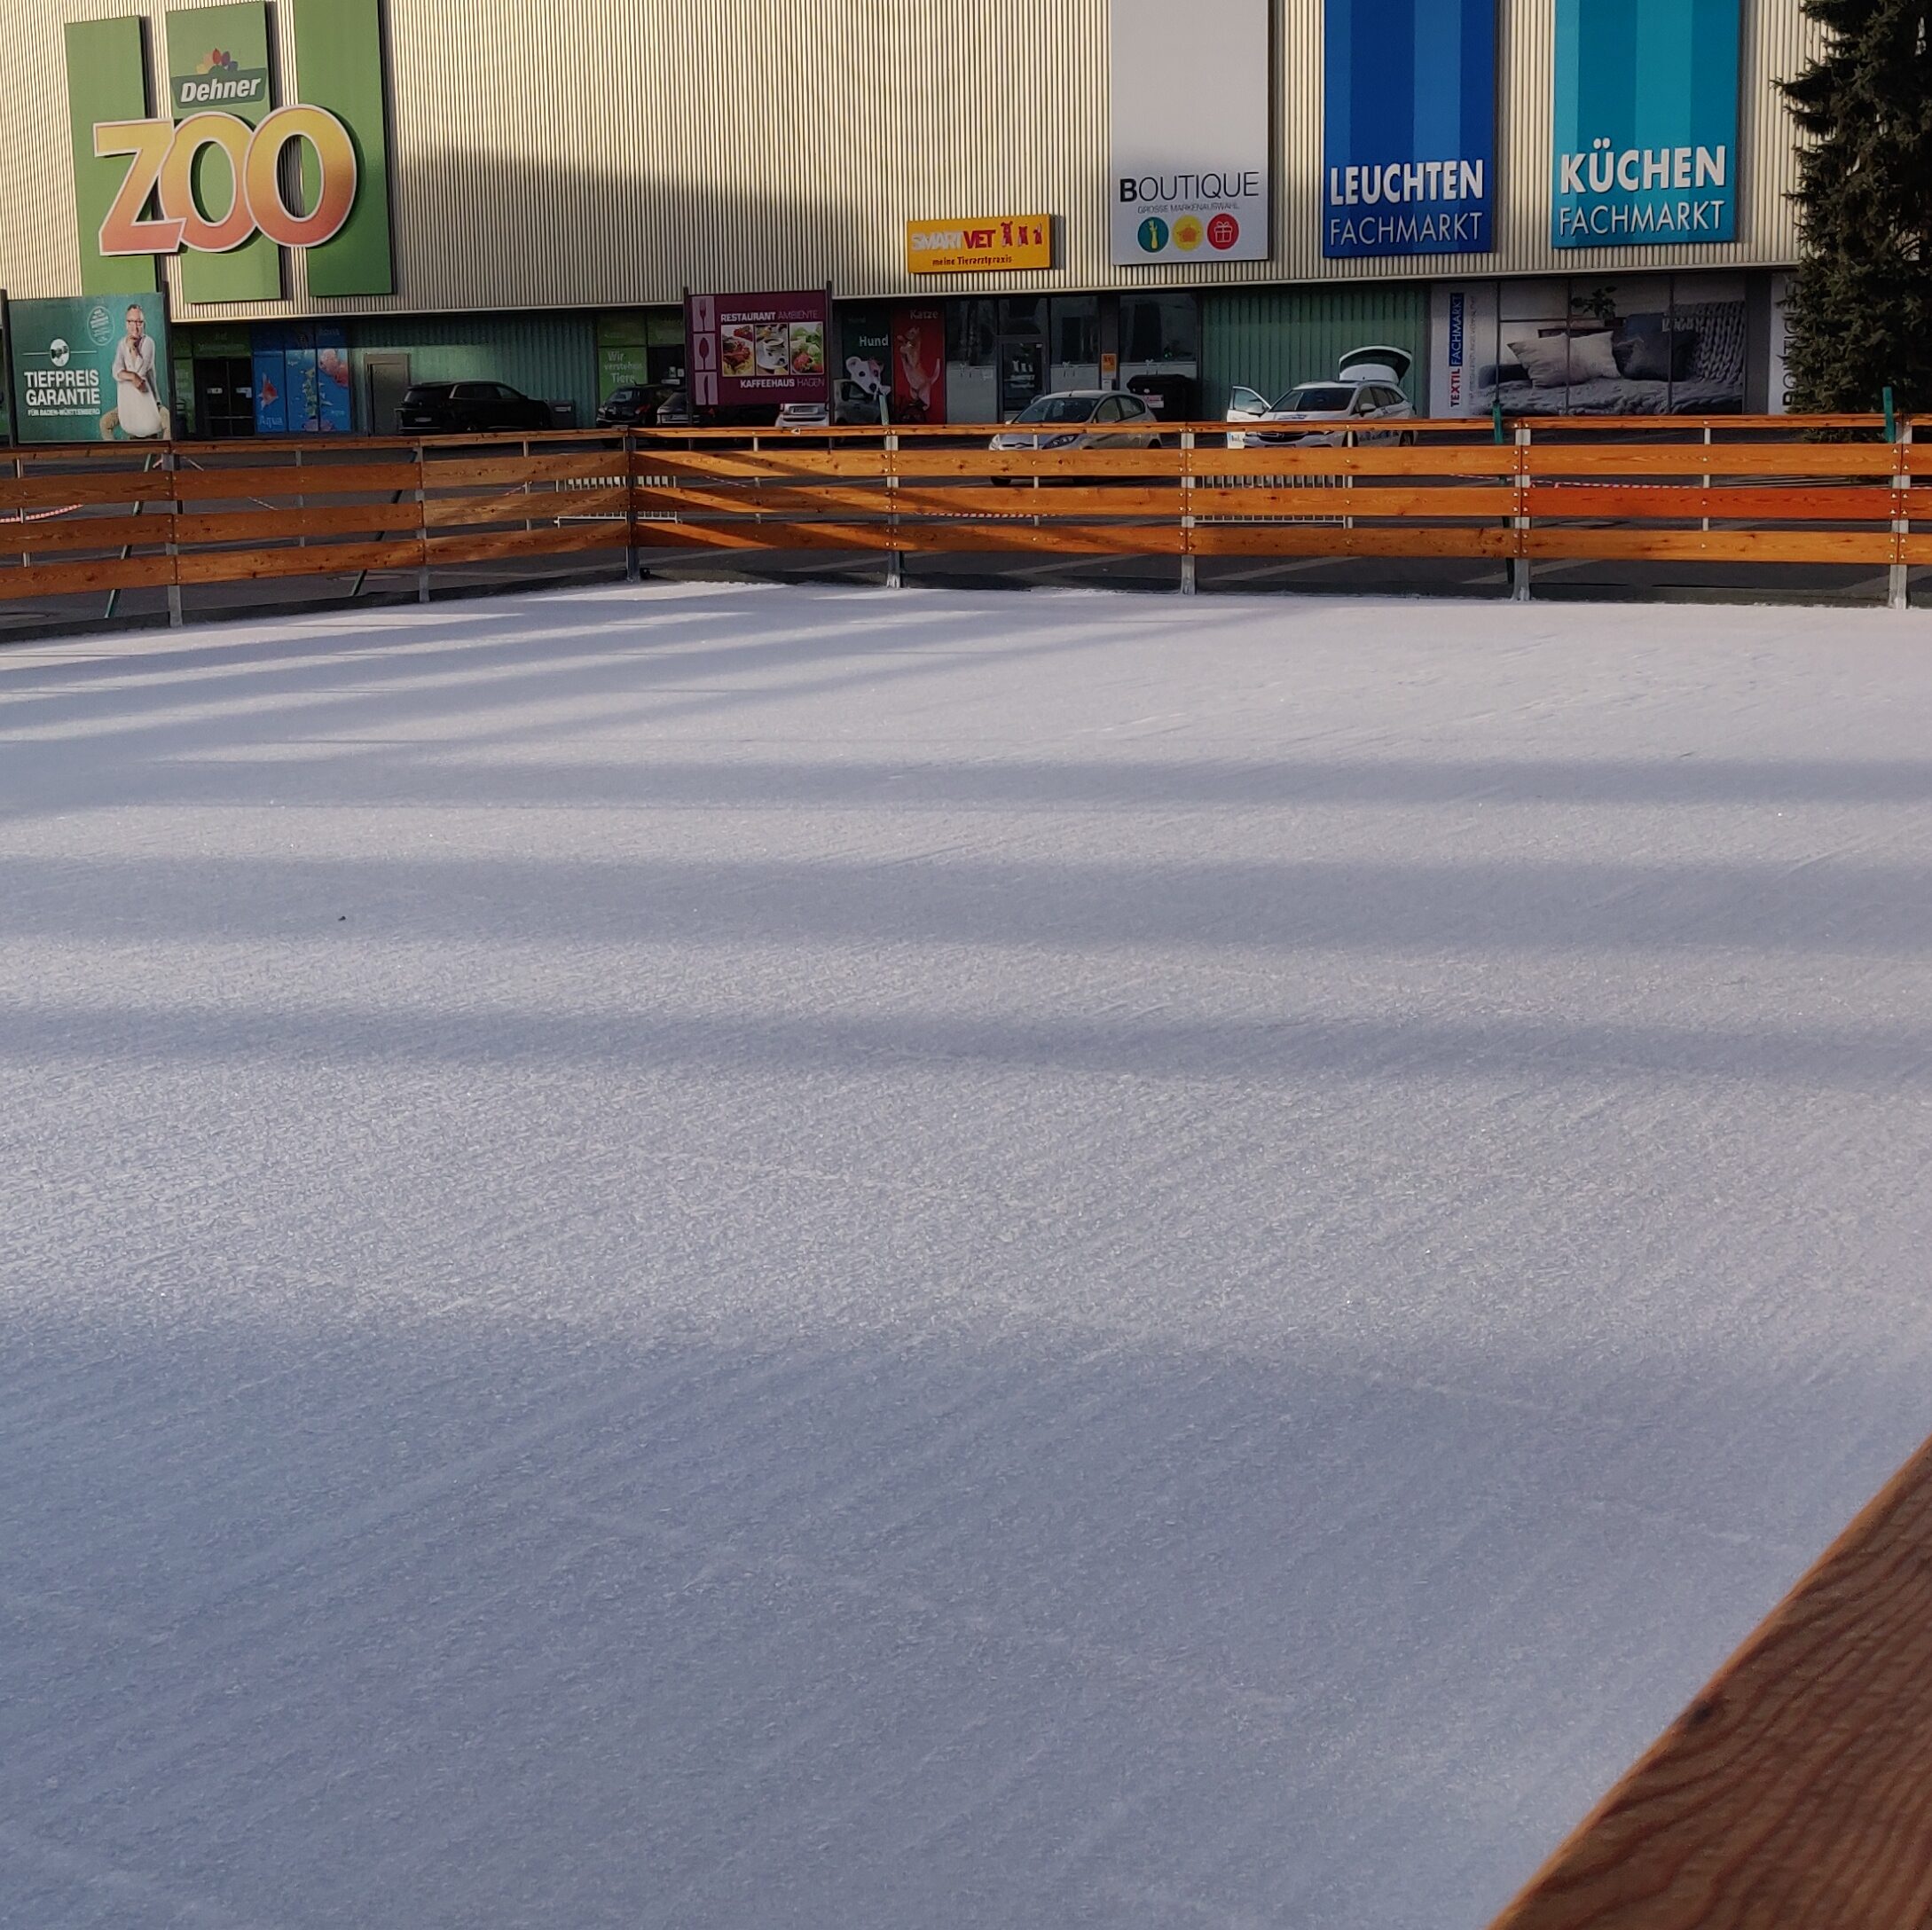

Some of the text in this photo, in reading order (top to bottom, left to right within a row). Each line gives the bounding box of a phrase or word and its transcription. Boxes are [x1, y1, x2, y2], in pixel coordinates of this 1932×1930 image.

[180, 78, 262, 103] Dehner
[1560, 137, 1726, 193] KÜCHEN
[92, 103, 357, 256] ZOO
[1119, 171, 1260, 203] BOUTIQUE
[1331, 159, 1484, 206] LEUCHTEN
[1137, 205, 1168, 215] GROSSE
[1559, 200, 1725, 237] FACHMARKT
[1331, 212, 1483, 246] FACHMARKT
[932, 254, 1013, 266] meine Tierarztpraxis
[720, 311, 776, 322] RESTAURANT
[859, 333, 889, 347] Hund
[1450, 294, 1463, 408] TEXTIL FACHMARKT
[24, 369, 99, 388] TIEFPREIS
[740, 378, 796, 388] KAFFEEHAUS
[26, 388, 101, 406] GARANTIE
[258, 415, 284, 428] Aqua
